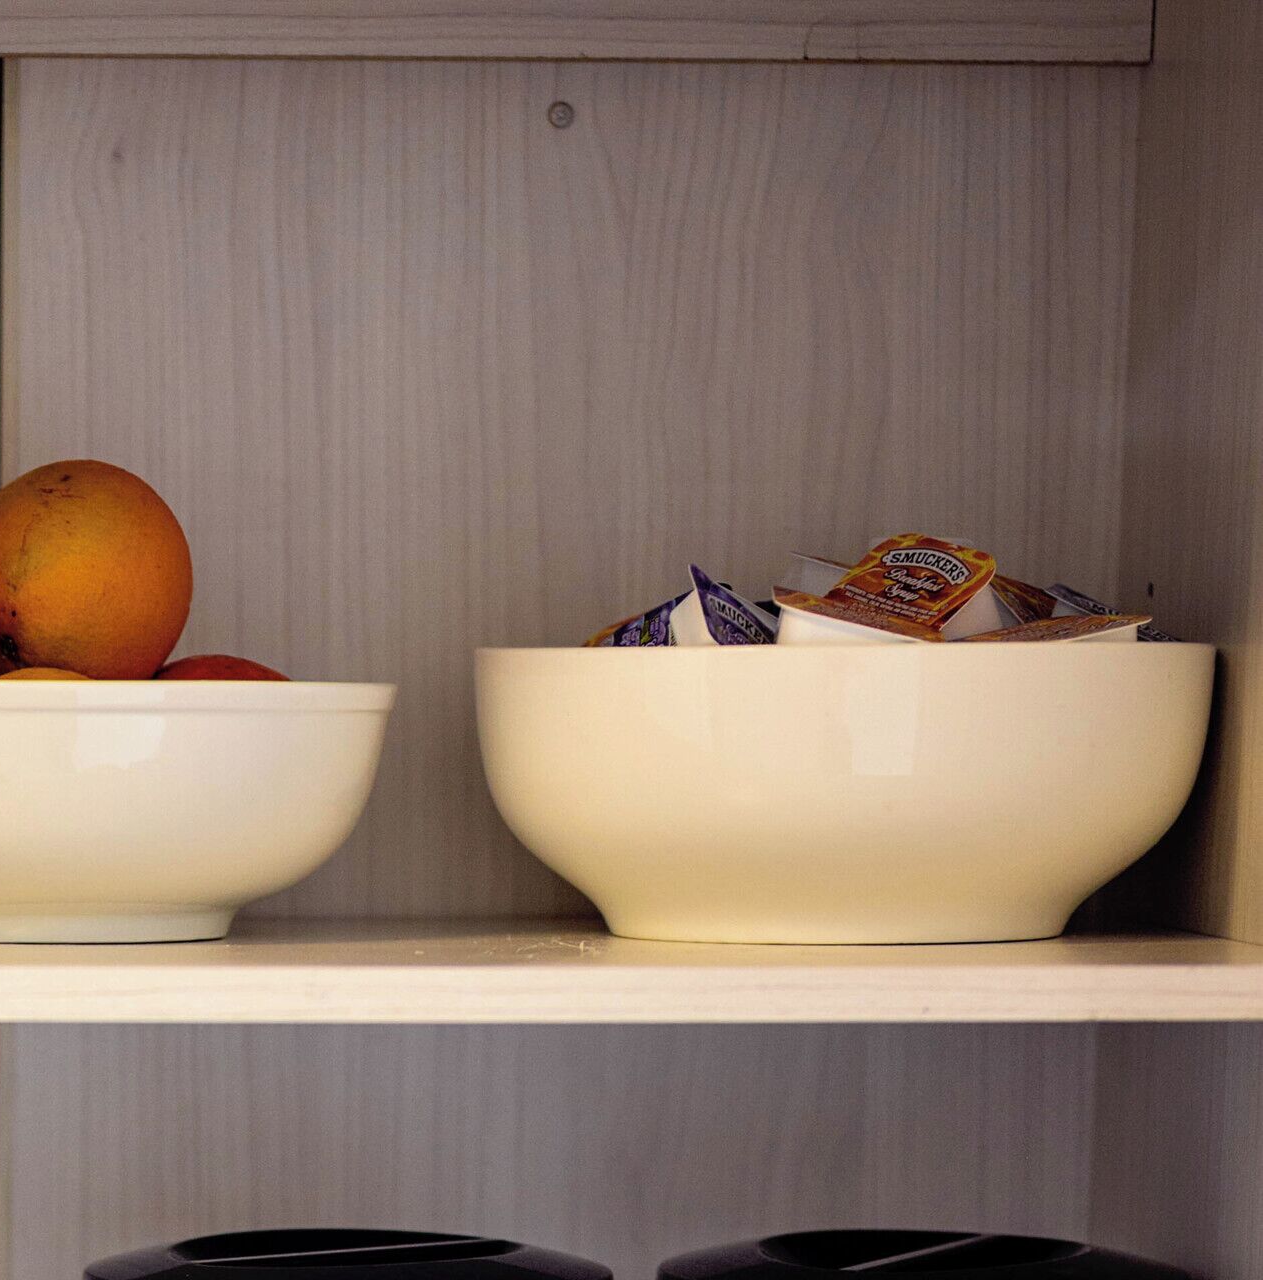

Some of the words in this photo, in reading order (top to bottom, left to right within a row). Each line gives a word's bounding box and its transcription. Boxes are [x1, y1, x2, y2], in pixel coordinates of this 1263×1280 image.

[884, 567, 946, 592] Breakfast
[889, 551, 966, 583] SMUCKER'S
[884, 583, 920, 602] Syrup
